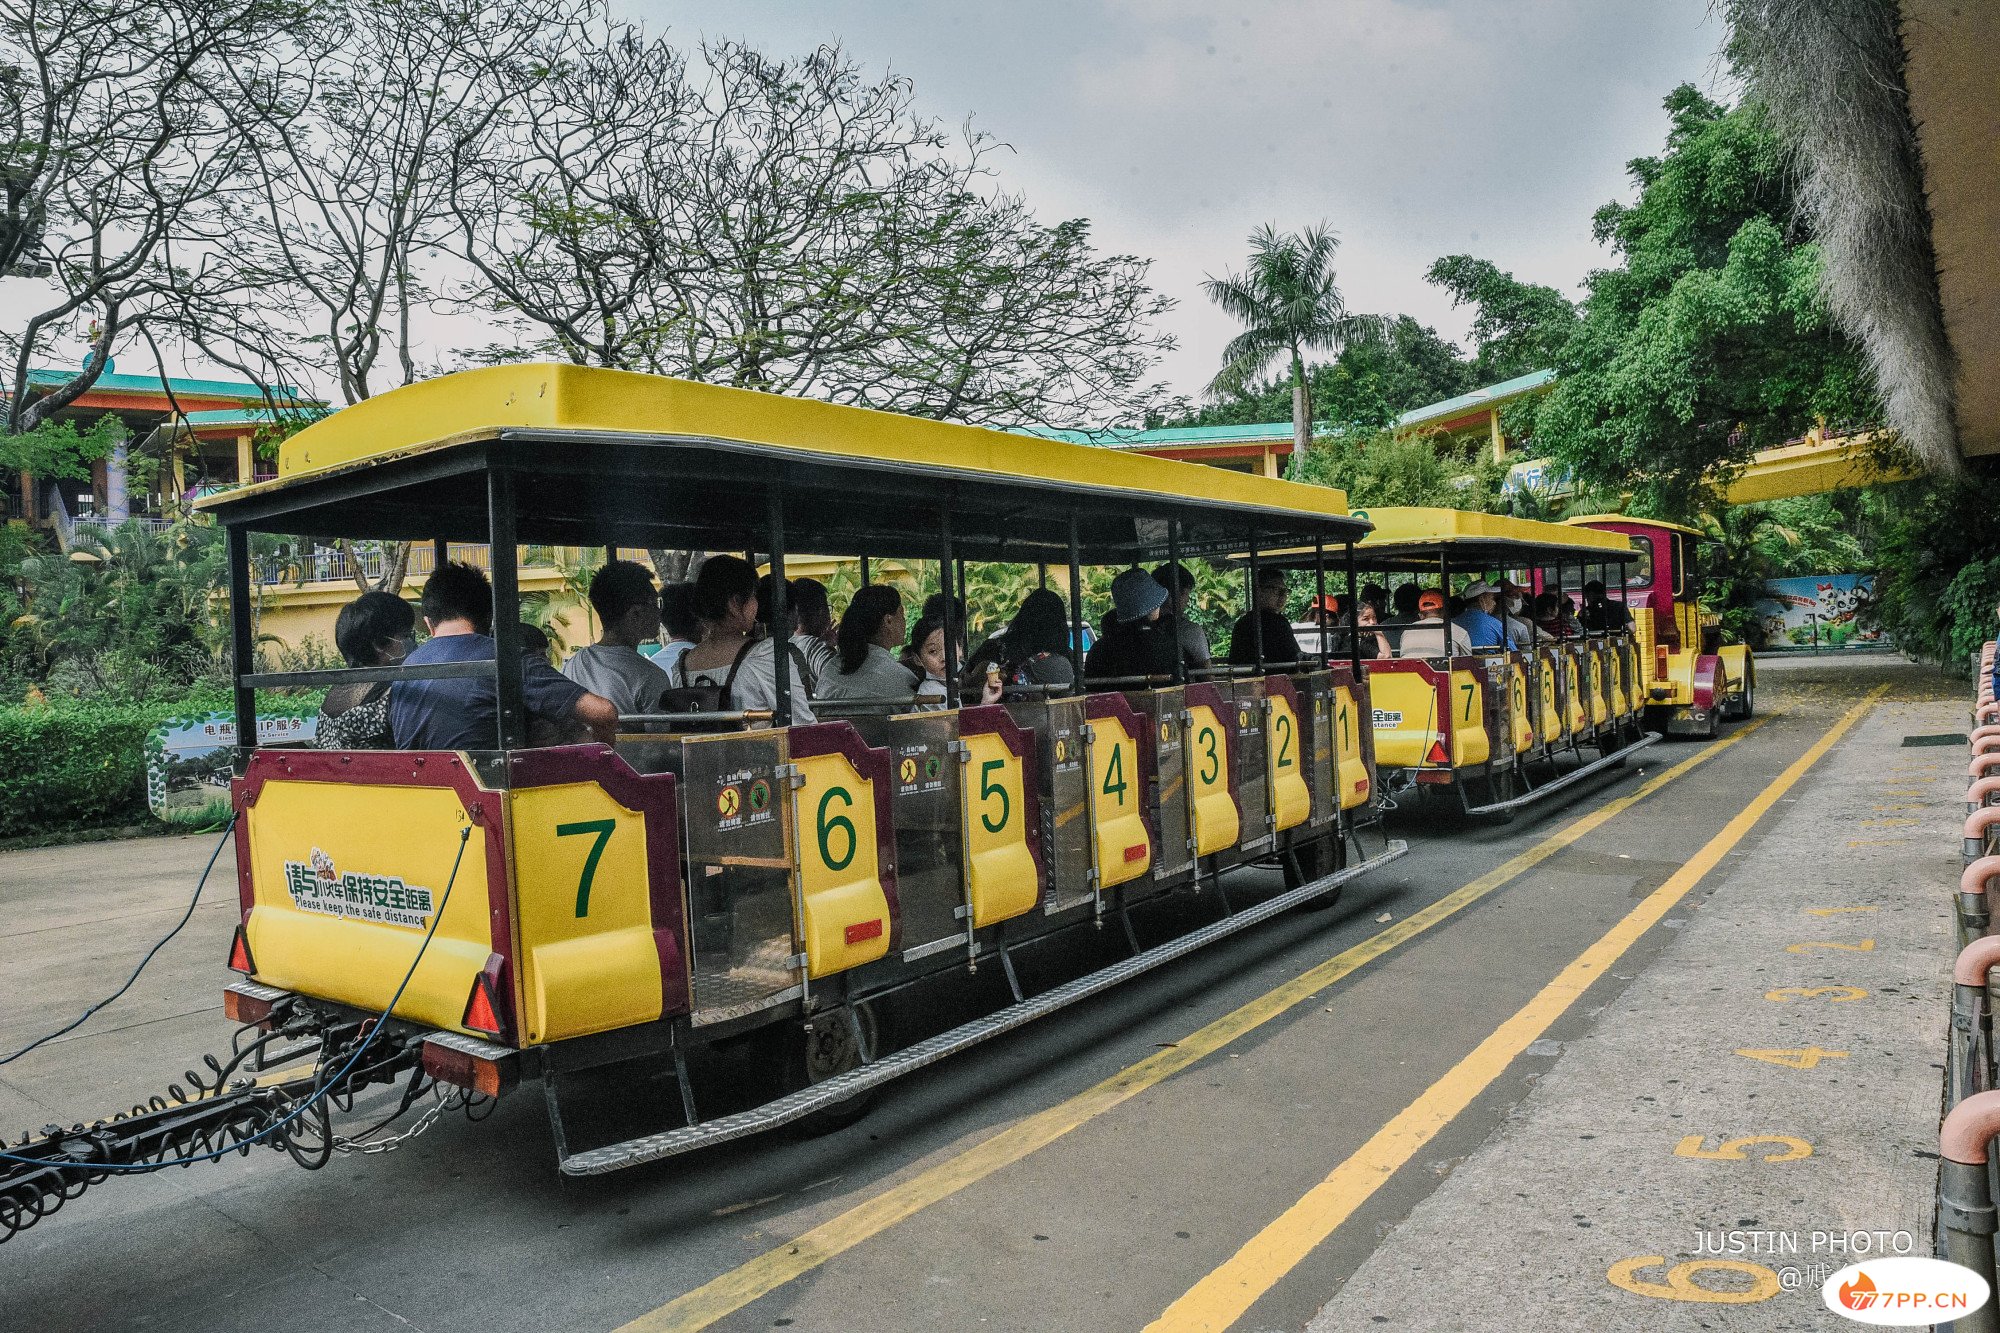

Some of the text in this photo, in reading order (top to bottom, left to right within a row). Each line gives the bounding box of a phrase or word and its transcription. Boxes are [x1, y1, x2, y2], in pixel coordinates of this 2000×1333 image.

[1544, 671, 1550, 704] 5
[1569, 667, 1576, 697] 4
[1593, 662, 1599, 691] 3
[1460, 684, 1475, 721] 7
[1513, 677, 1522, 712] 6
[204, 718, 302, 736] 电瓶IP服务
[1275, 715, 1292, 768] 2
[1338, 704, 1349, 752] 1
[1198, 727, 1219, 785] 3
[1103, 743, 1127, 806] 4
[981, 759, 1010, 833] 5
[816, 786, 857, 871] 6
[556, 818, 616, 918] 7
[294, 895, 426, 926] Please keep the safe distance
[1785, 938, 1876, 953] 2
[1764, 986, 1869, 1002] 3
[1733, 1046, 1850, 1069] 4
[1673, 1135, 1814, 1162] 5
[1606, 1255, 1782, 1304] 6
